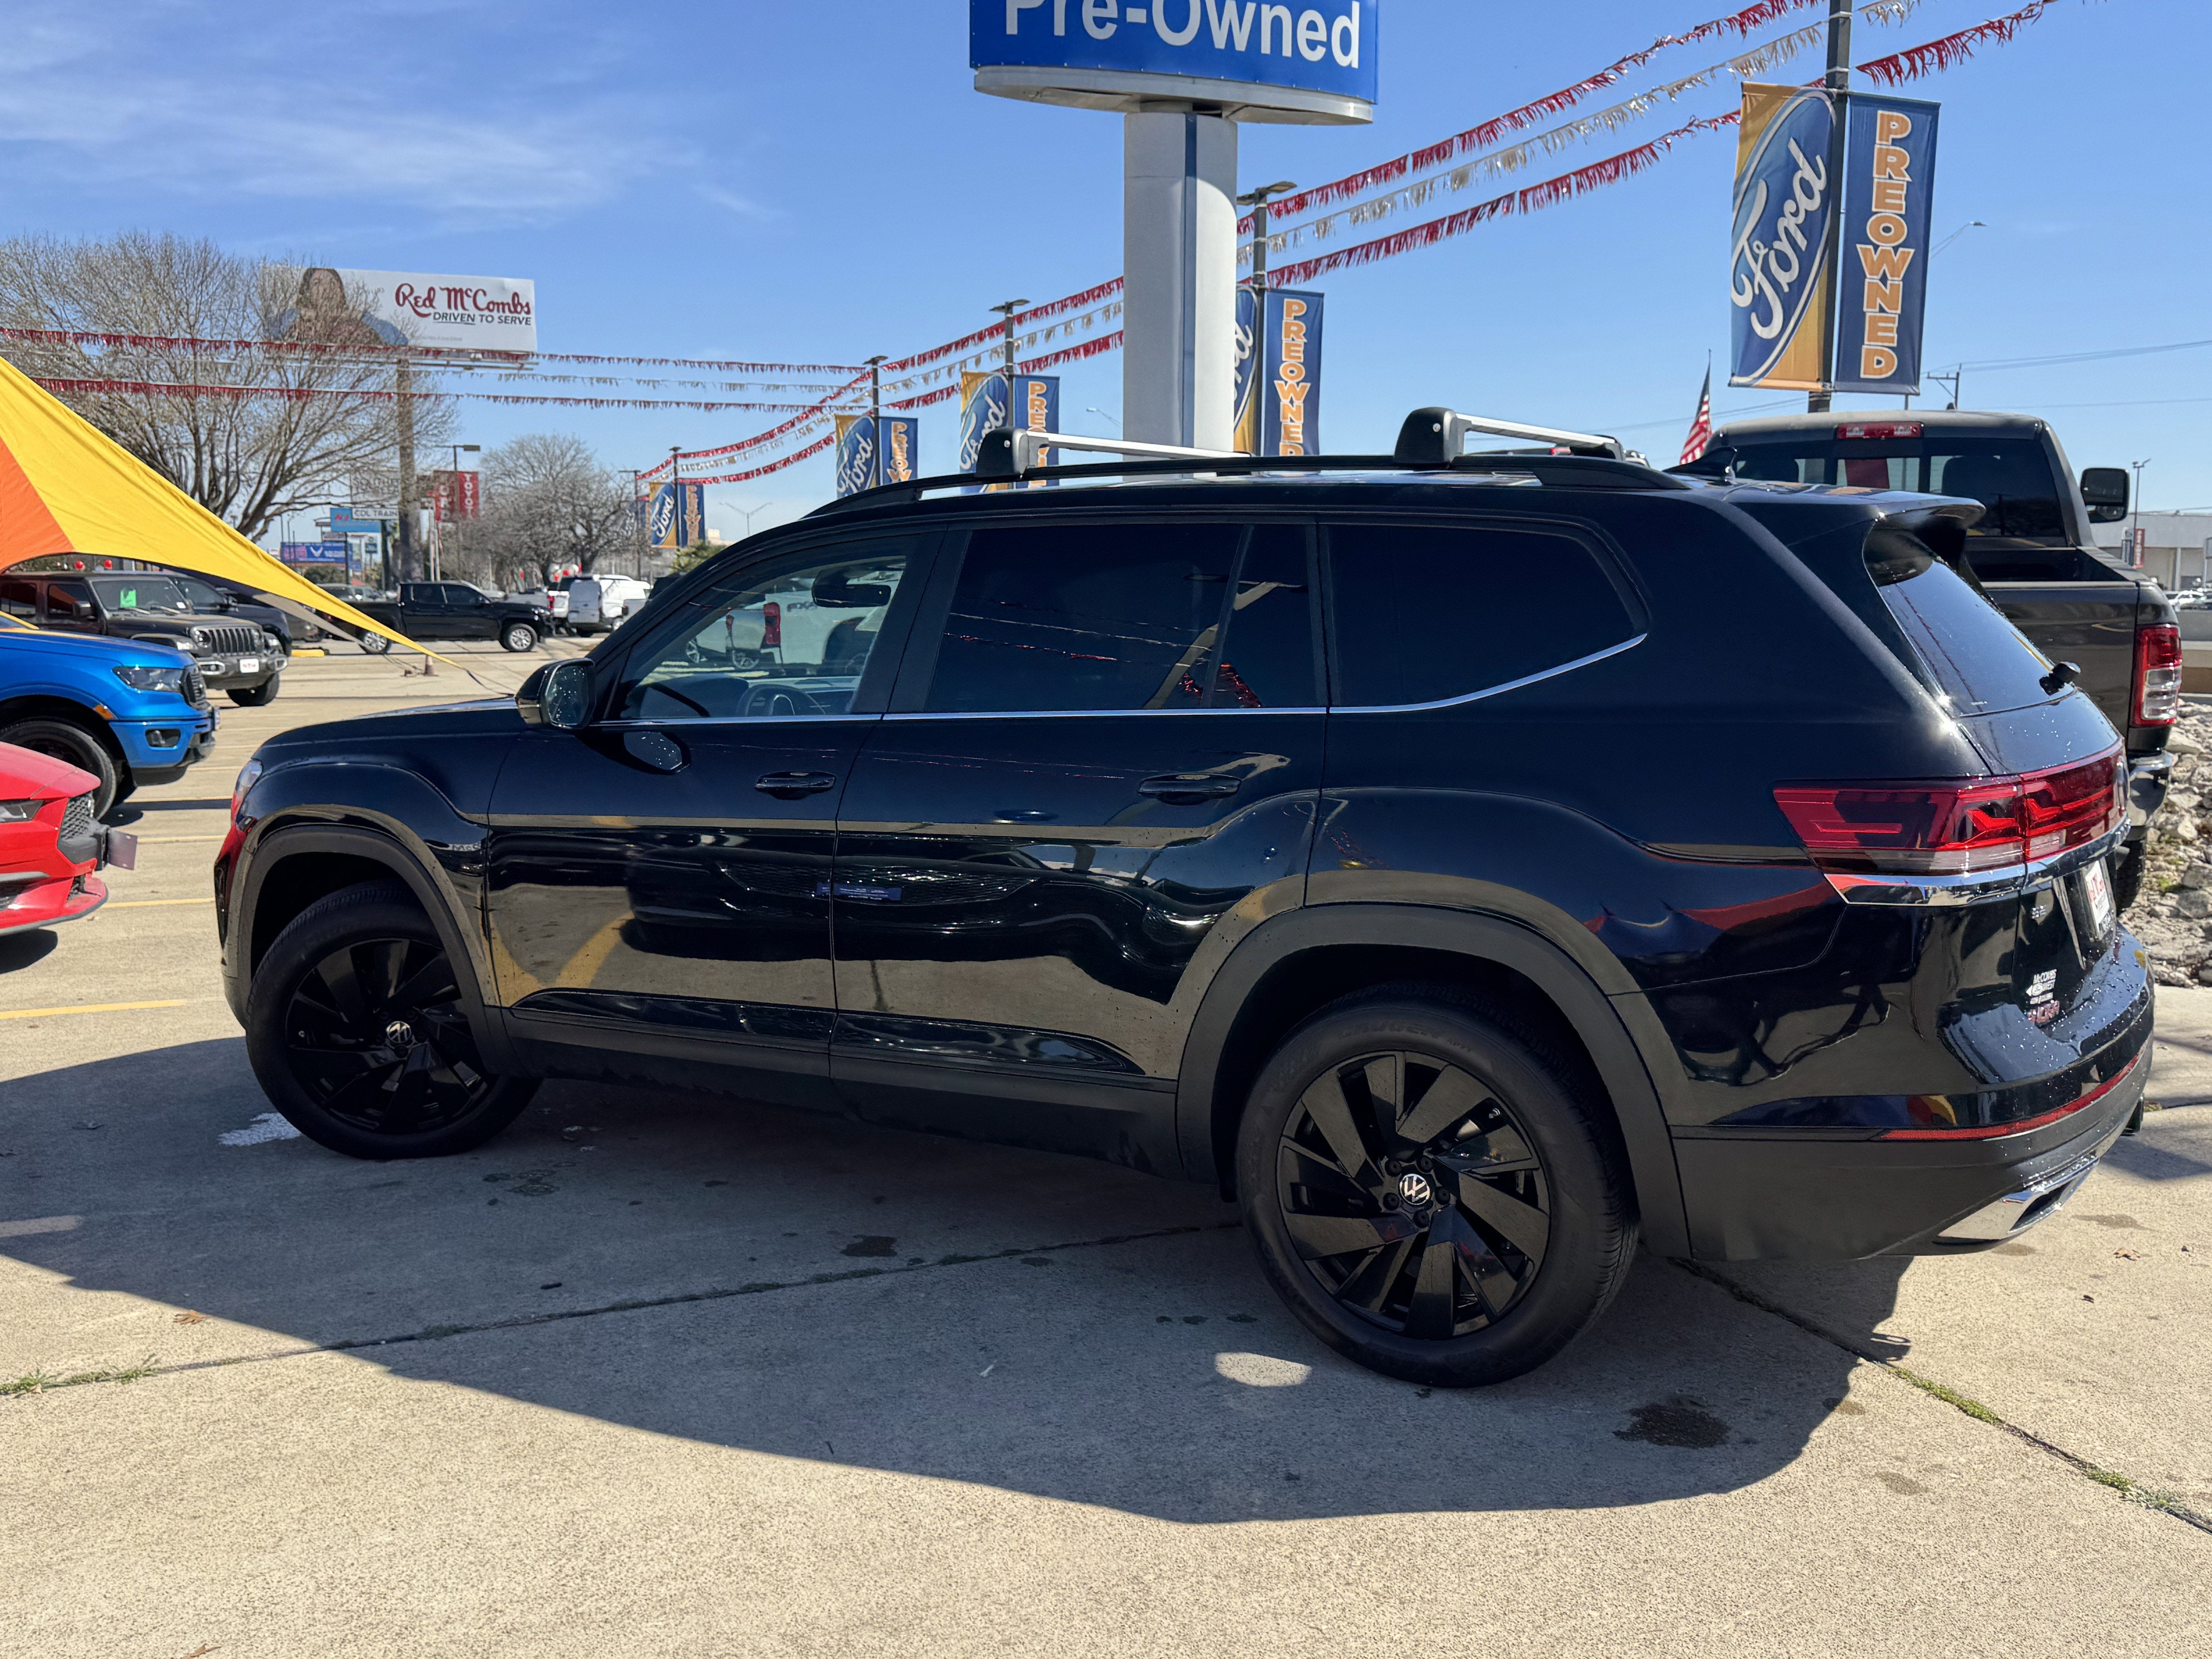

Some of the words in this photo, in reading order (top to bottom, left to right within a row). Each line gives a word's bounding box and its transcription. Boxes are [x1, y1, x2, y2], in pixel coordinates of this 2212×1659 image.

[1006, 0, 1359, 69] Pre-Owned
[1731, 137, 1827, 339] Ford
[1856, 110, 1915, 379] PREOWNED
[395, 283, 436, 318] Red
[439, 287, 531, 315] McCombs
[433, 312, 476, 323] DRIVEN
[479, 314, 495, 324] TO
[498, 315, 532, 326] SERVE
[652, 492, 675, 538] Ford
